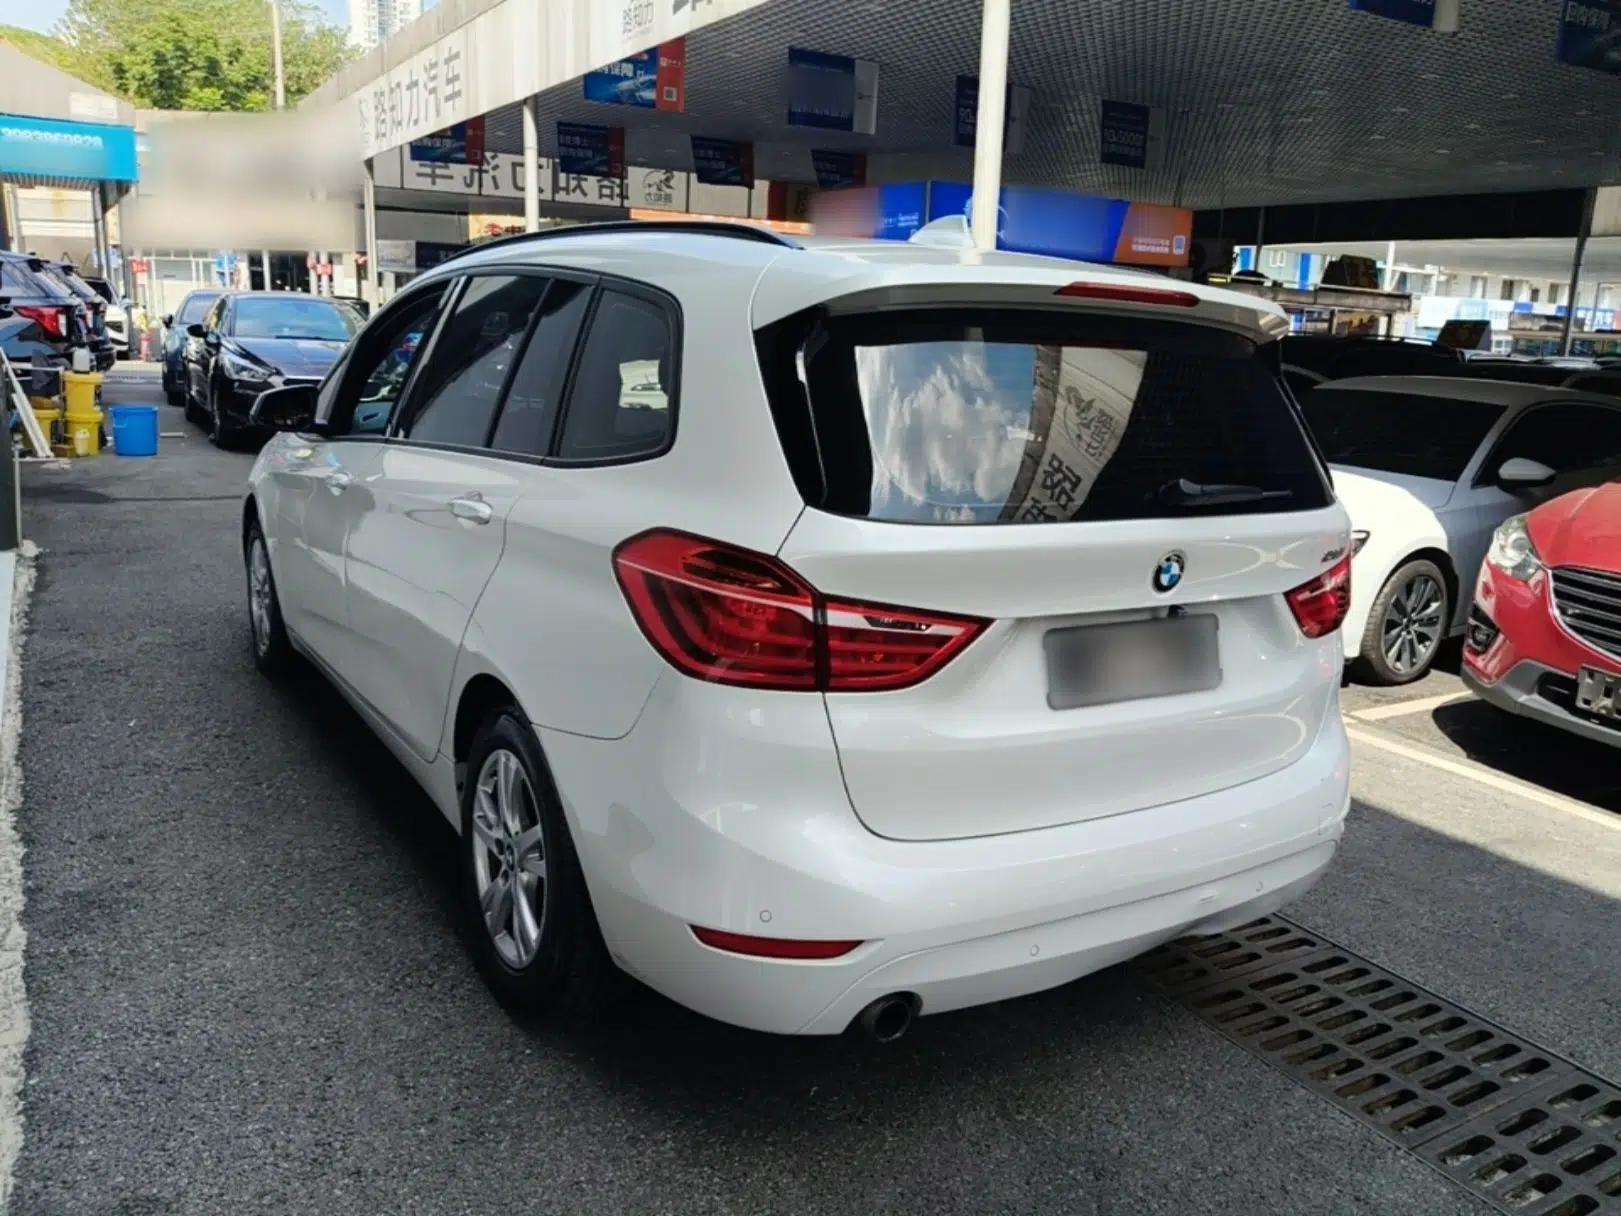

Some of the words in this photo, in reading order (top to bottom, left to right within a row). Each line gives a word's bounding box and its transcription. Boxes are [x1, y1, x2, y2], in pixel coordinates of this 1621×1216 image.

[373, 46, 462, 140] 路知力汽车
